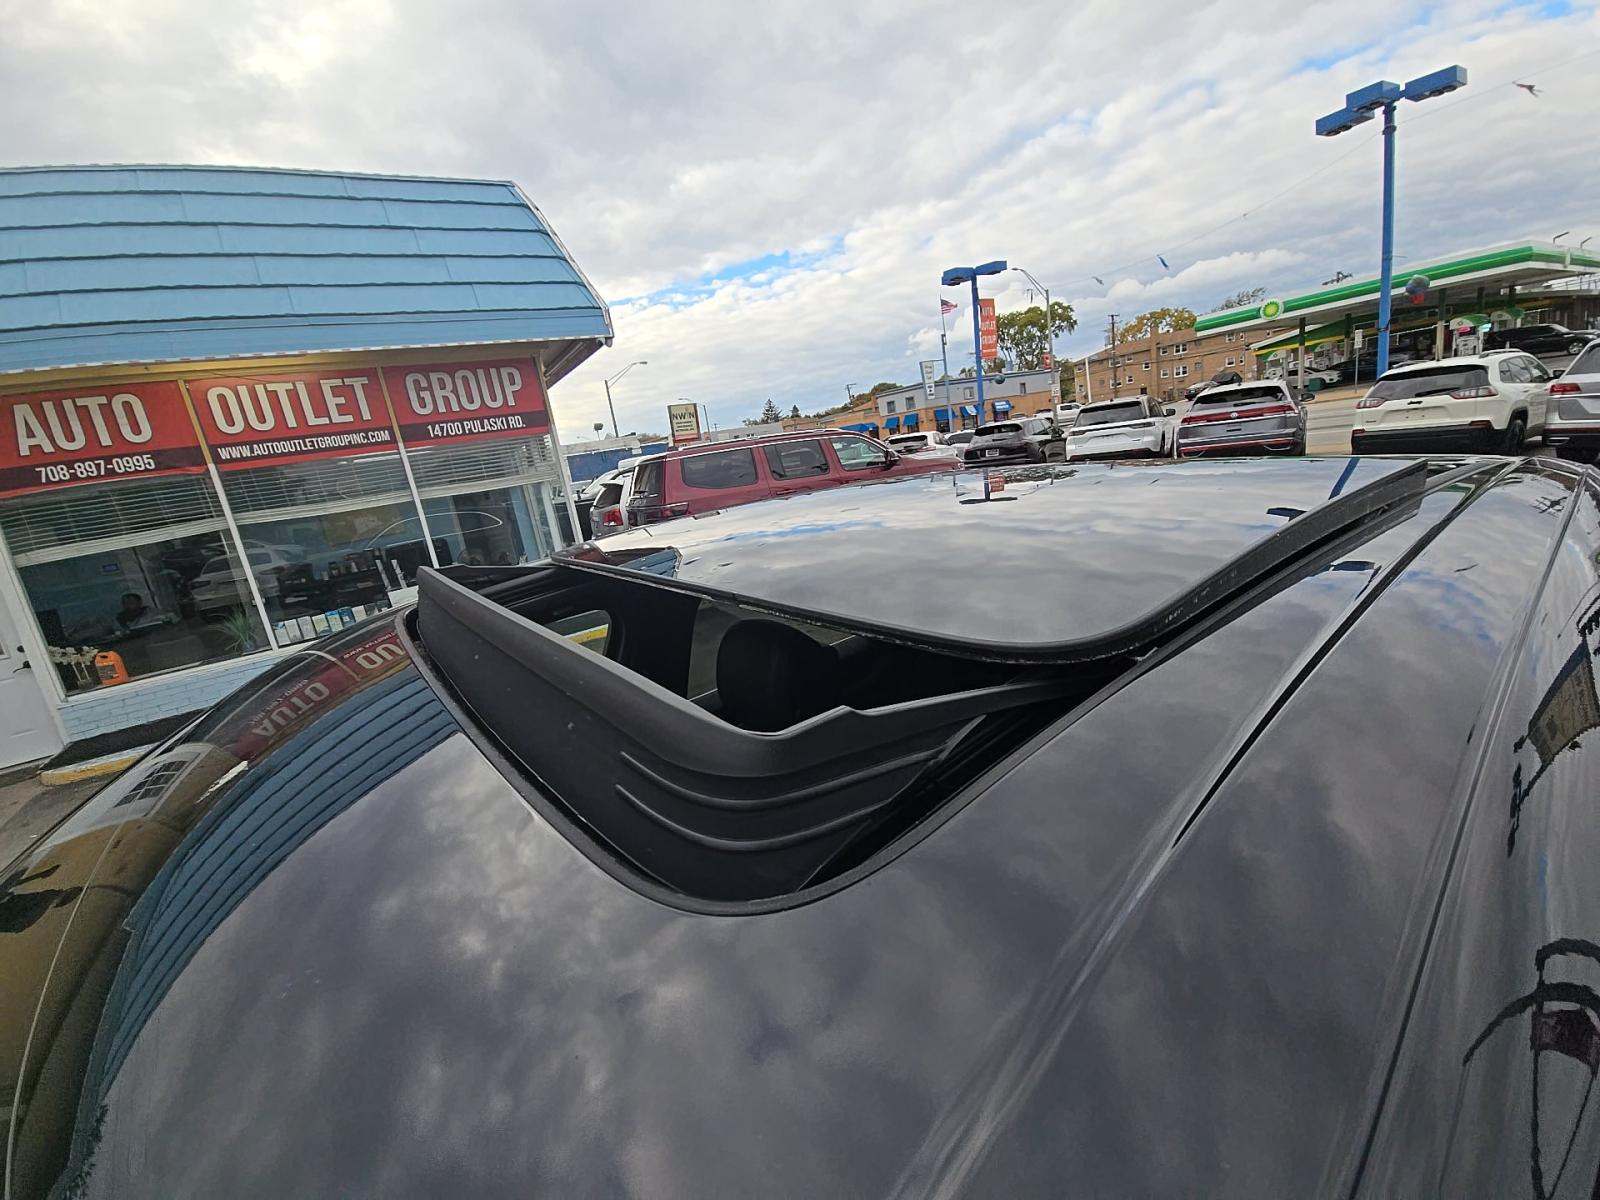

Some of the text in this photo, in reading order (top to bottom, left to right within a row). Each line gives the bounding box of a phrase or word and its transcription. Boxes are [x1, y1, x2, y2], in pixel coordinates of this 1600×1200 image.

[13, 366, 522, 456] AUTO OUTLET GROUP
[427, 415, 526, 438] 14700 PULASKI RD.
[218, 430, 390, 460] WWW.AUTOOUTLETGROUPINC.COM
[35, 454, 156, 483] 708-897-0995
